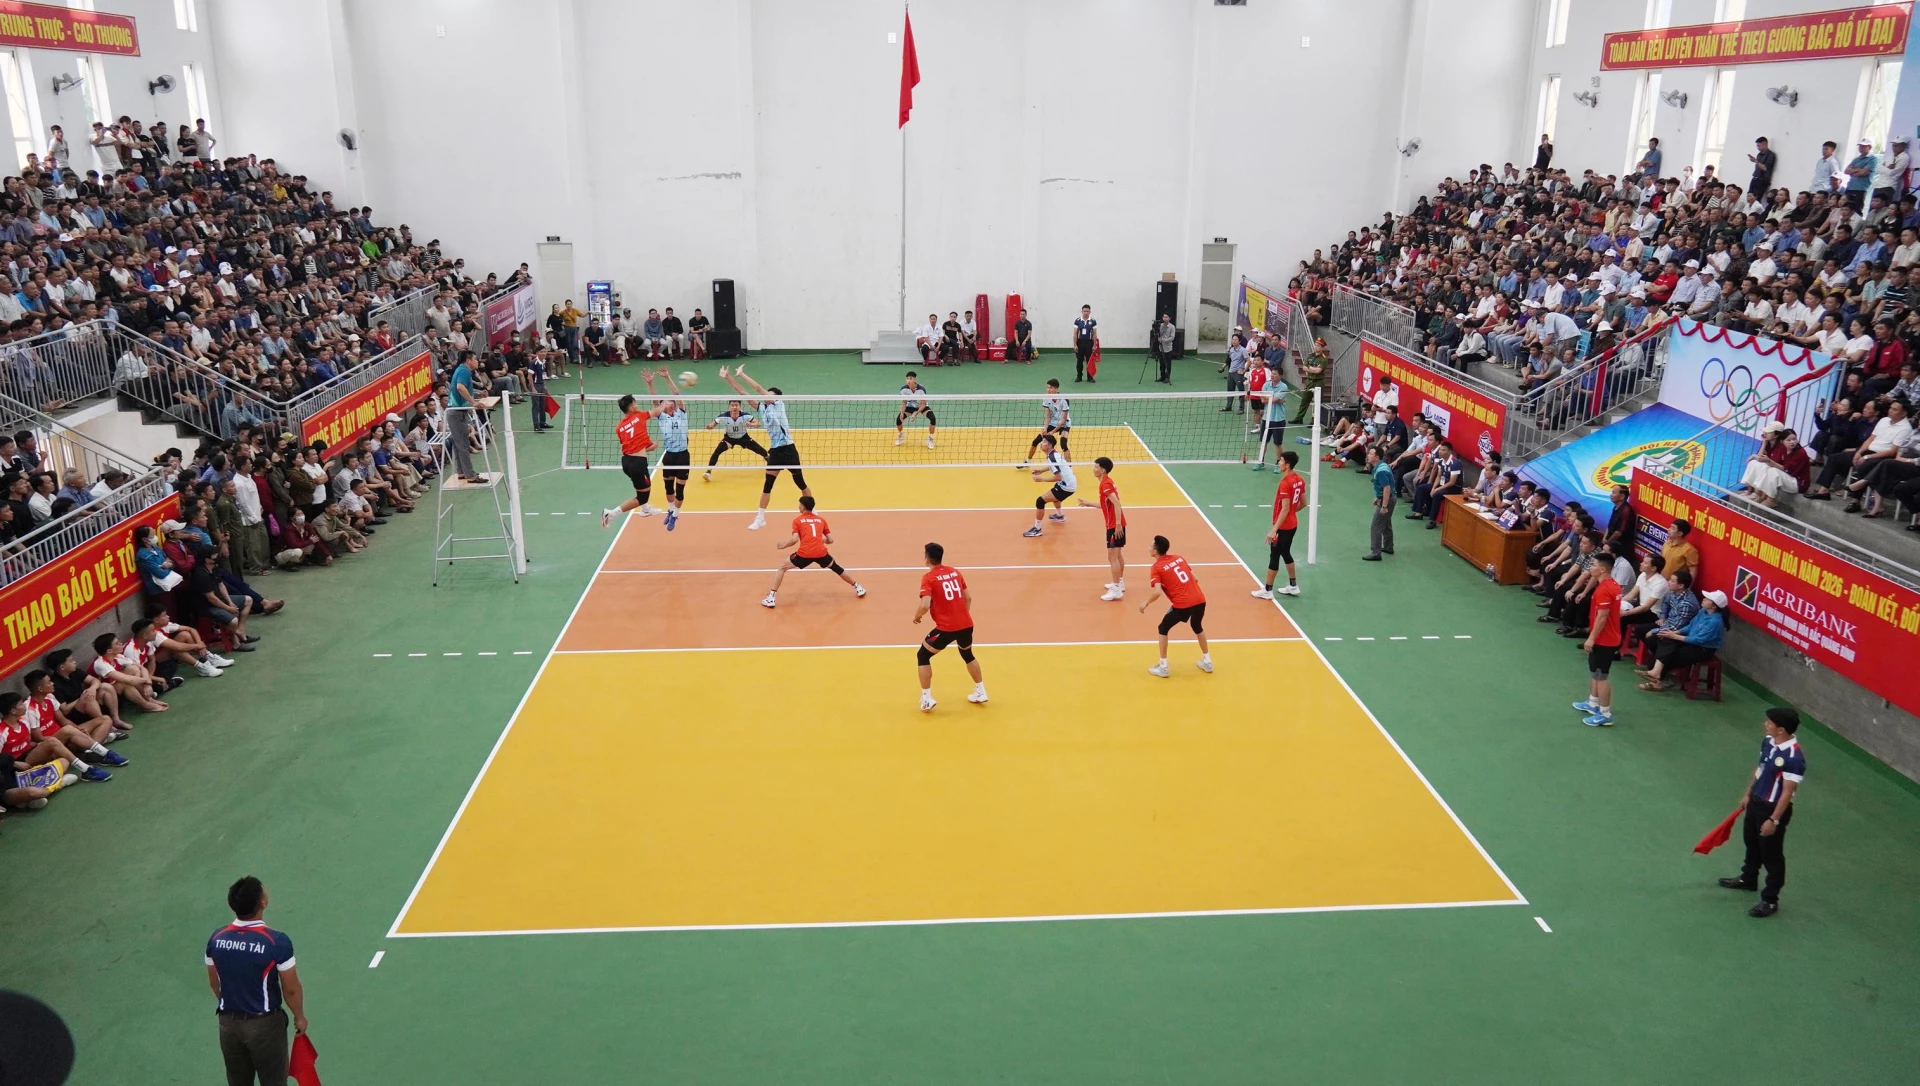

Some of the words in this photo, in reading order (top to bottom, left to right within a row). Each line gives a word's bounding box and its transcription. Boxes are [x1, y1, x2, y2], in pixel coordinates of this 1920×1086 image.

[35, 17, 65, 45] THỰC
[73, 22, 94, 44] CAO
[94, 24, 132, 50] THƯỢNG
[1609, 38, 1630, 63] TOÀN
[1629, 36, 1647, 62] DÂN
[1647, 34, 1665, 60] RÈN
[1665, 32, 1694, 64] LUYỆN
[1694, 30, 1720, 58] THÂN
[1720, 22, 1742, 56] THỂ
[1740, 30, 1766, 55] THEO
[1767, 24, 1806, 53] GƯƠNG
[1807, 18, 1834, 50] BÁC
[1855, 14, 1872, 46] VĨ
[1870, 16, 1896, 50] ĐẠI
[341, 409, 356, 438] XÂY
[356, 399, 376, 430] DỰNG
[375, 390, 386, 416] VÀ
[385, 381, 398, 410] BẢO
[626, 427, 634, 438] 7
[809, 523, 816, 537] 1
[1648, 524, 1668, 542] EVENTS
[1638, 482, 1655, 506] TUẦN
[1654, 486, 1663, 510] LỄ
[1662, 494, 1677, 516] VĂN
[1675, 500, 1690, 521] HÓA
[1694, 507, 1709, 532] THỂ
[1707, 516, 1726, 540] THAO
[1730, 527, 1742, 548] DU
[1741, 532, 1760, 557] LỊCH
[1758, 540, 1782, 568] MINH
[1780, 550, 1798, 577] HÓA
[1798, 558, 1821, 587] NĂM
[1819, 570, 1844, 598] 2026
[1848, 583, 1878, 615] ĐOÀN
[1876, 593, 1898, 628] KẾT,
[1174, 566, 1189, 583] 6
[4, 592, 56, 650] THAO
[57, 566, 94, 618] BẢO
[94, 549, 118, 594] VỆ
[117, 530, 136, 578] TỔ
[942, 579, 962, 600] 84
[1761, 582, 1858, 643] AGRIBANK
[215, 939, 246, 952] TRỌNG
[249, 941, 265, 954] TÀI
